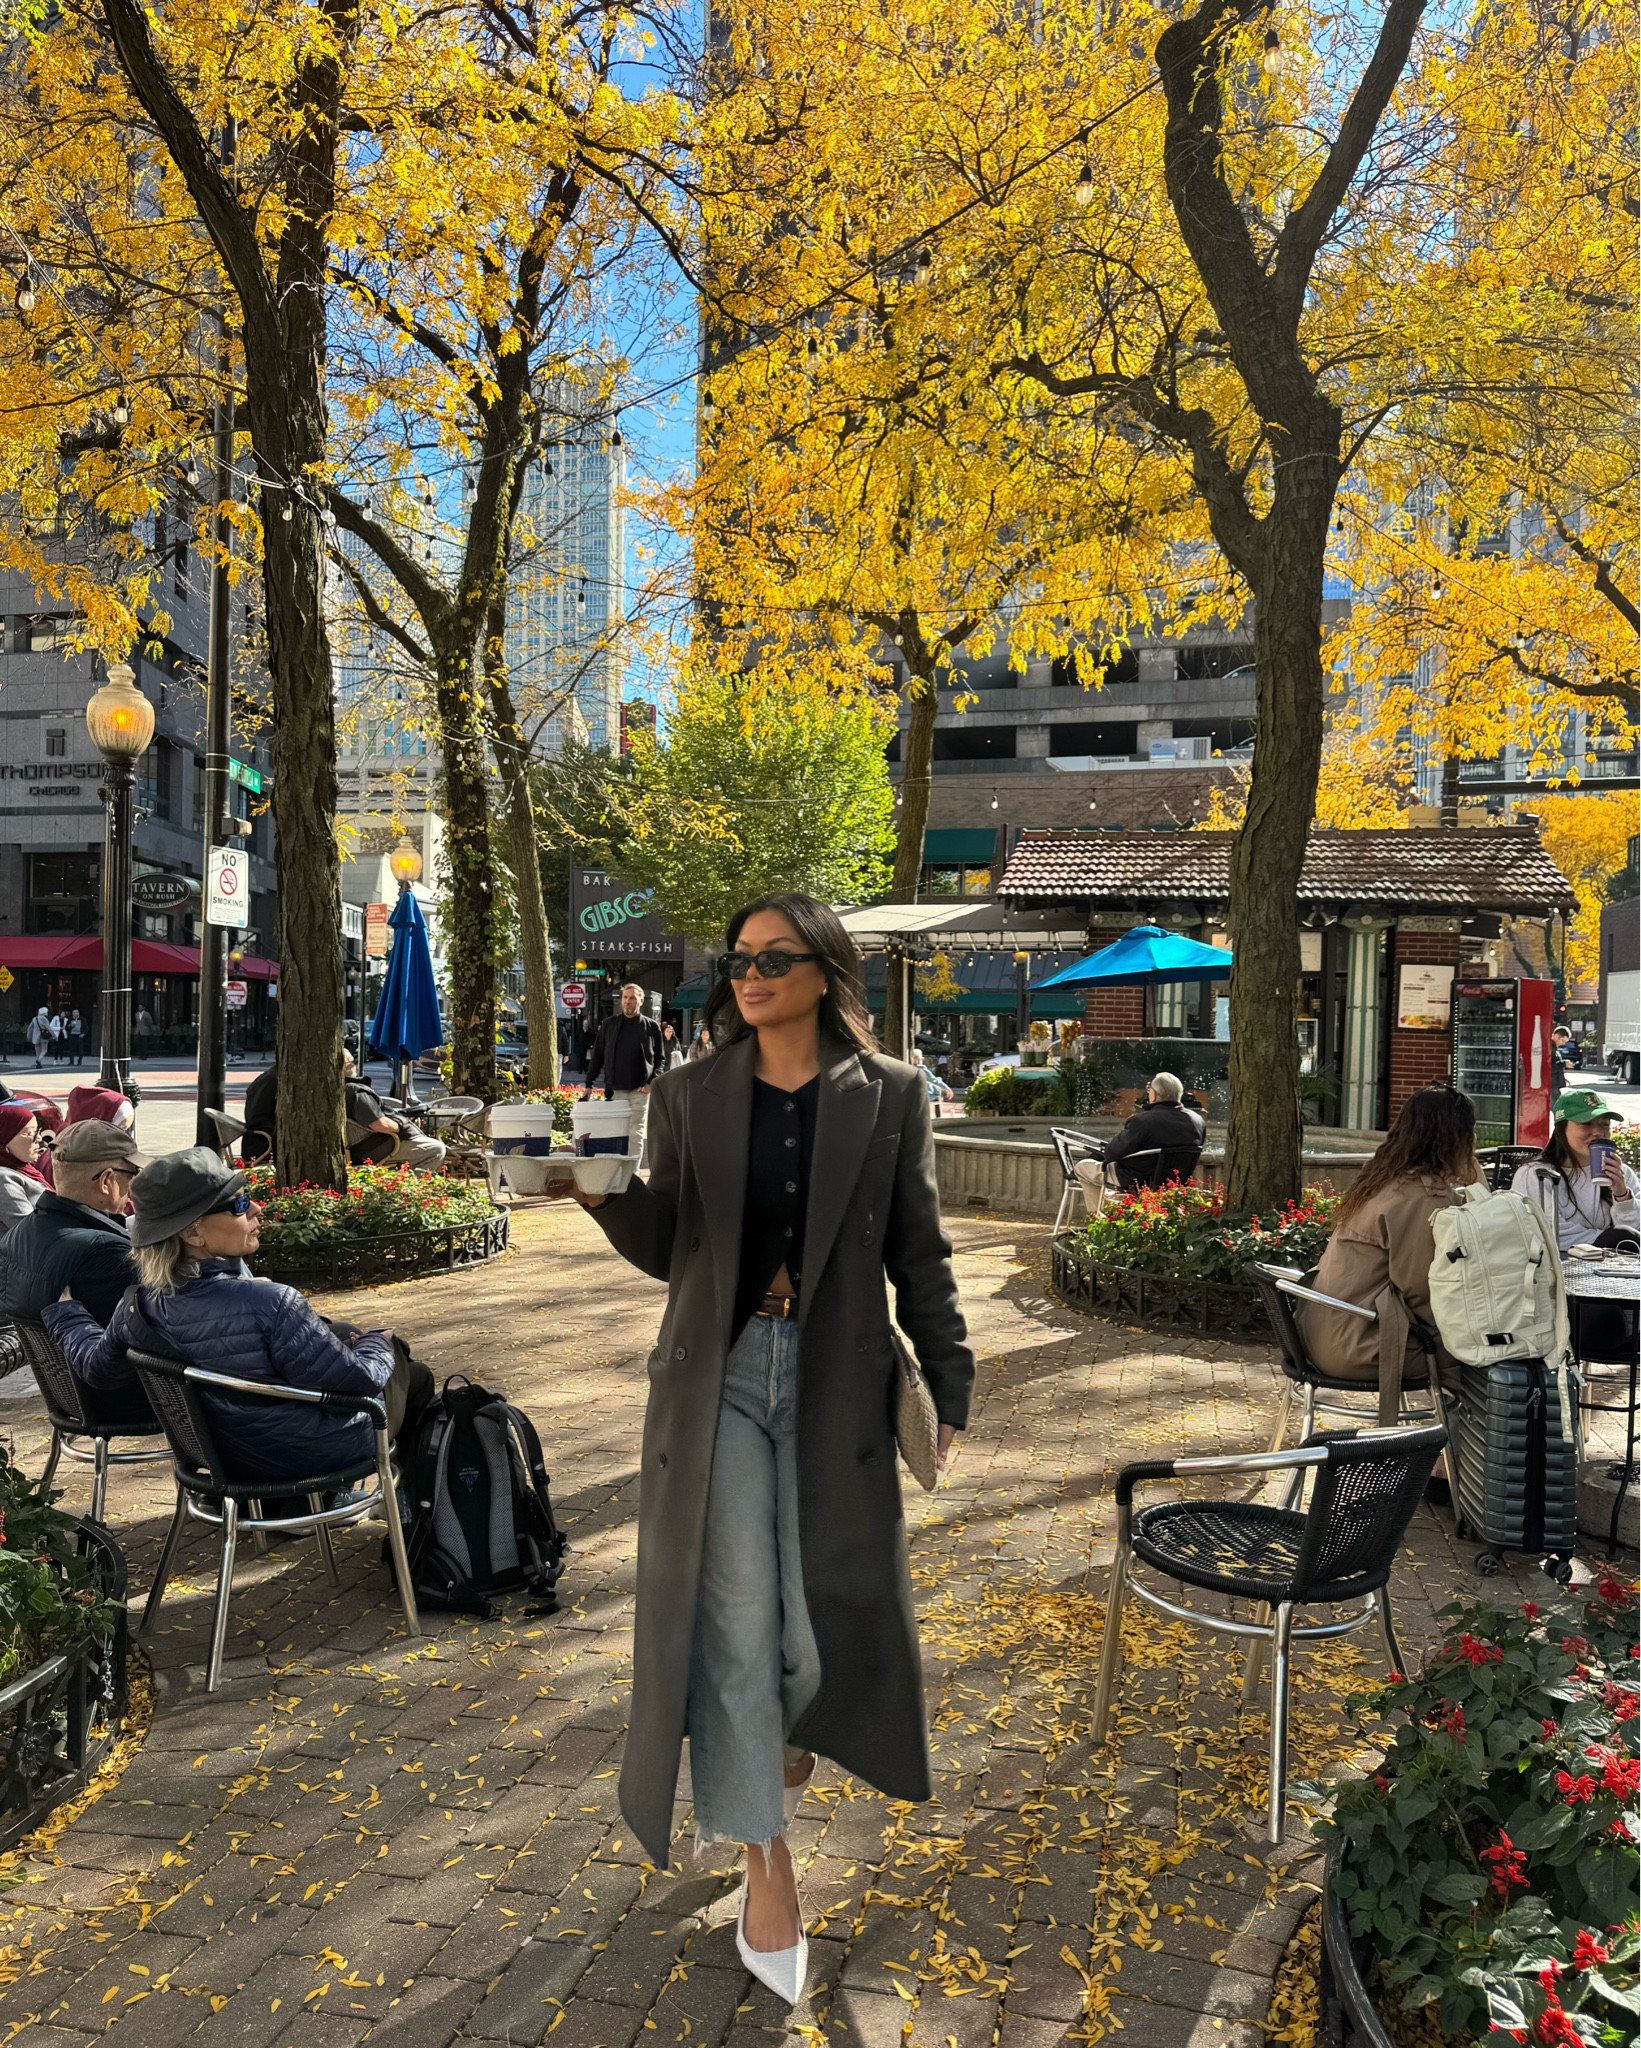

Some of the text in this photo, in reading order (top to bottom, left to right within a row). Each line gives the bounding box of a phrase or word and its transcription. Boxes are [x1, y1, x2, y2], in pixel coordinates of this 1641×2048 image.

[222, 853, 237, 867] NO
[583, 875, 611, 886] BAR
[132, 882, 185, 893] TAVERN
[212, 896, 244, 908] SMOKING
[581, 941, 672, 953] STEAKS-FISH
